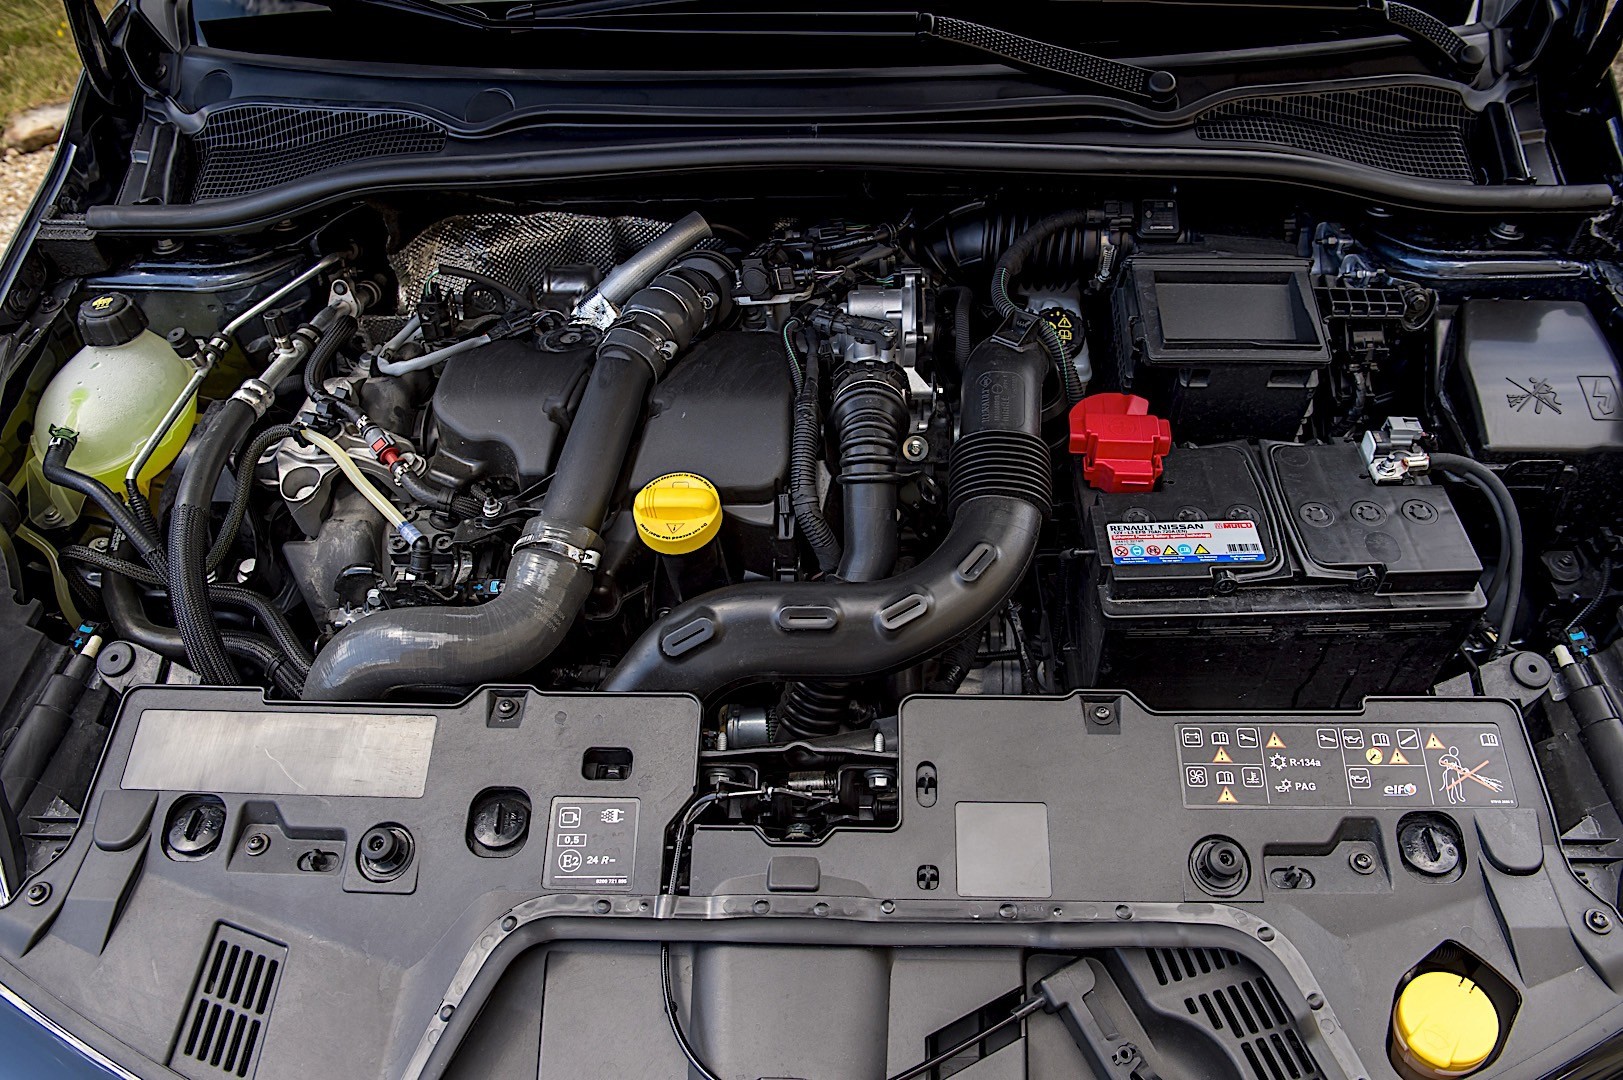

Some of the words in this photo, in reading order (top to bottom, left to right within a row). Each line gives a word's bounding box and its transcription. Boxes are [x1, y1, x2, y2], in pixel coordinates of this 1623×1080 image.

[1289, 758, 1321, 767] R-134a
[1295, 783, 1317, 791] PAG
[564, 836, 580, 845] 0,5
[562, 854, 580, 868] E2
[586, 856, 598, 865] 24
